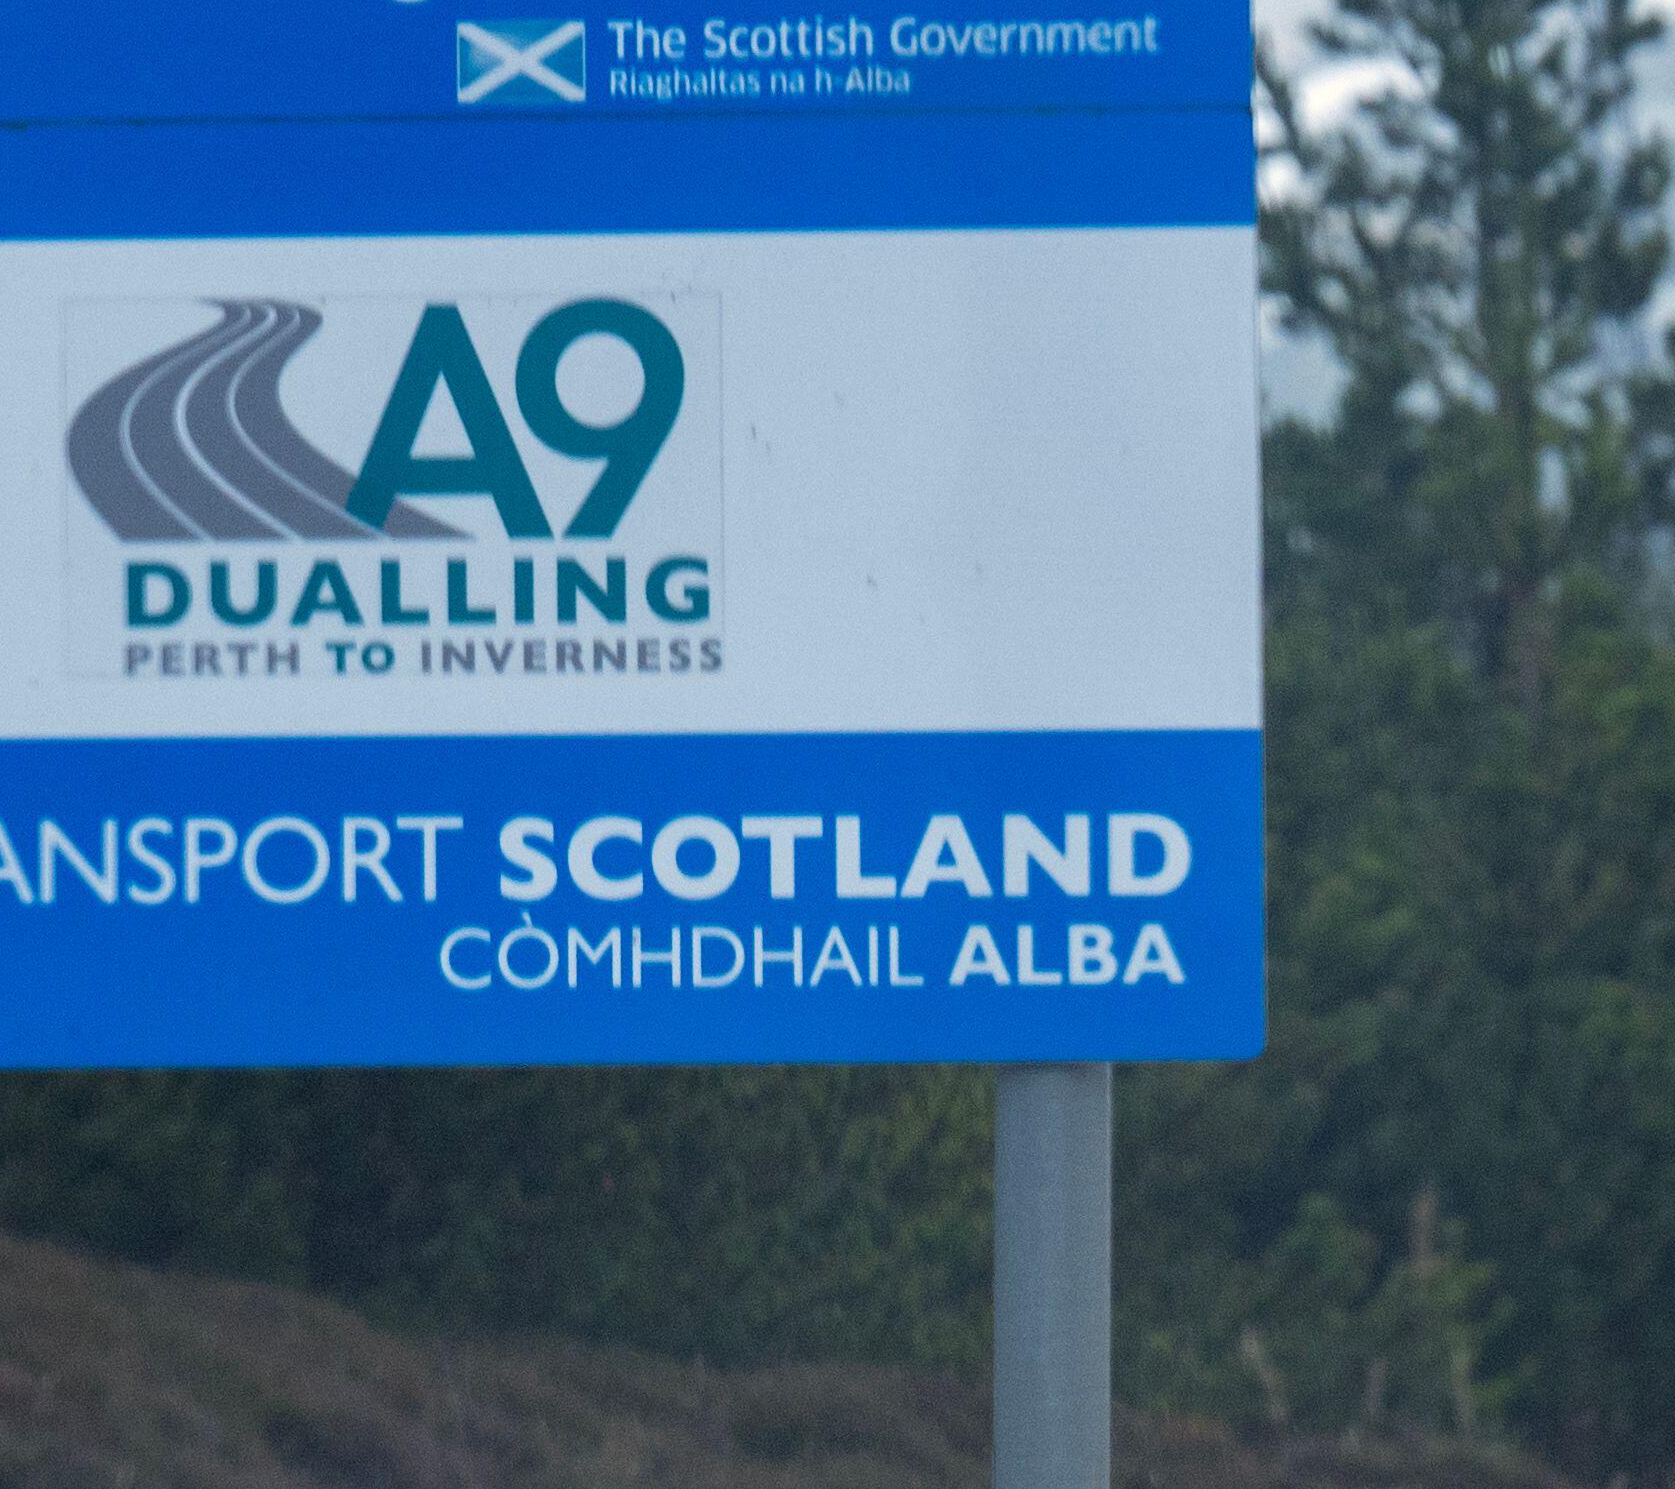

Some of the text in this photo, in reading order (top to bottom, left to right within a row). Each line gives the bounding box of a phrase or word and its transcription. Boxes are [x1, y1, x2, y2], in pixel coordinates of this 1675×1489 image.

[608, 17, 1156, 58] The Scottish Government
[609, 69, 760, 98] Riaghaltas
[770, 73, 805, 92] na
[347, 296, 685, 540] A9
[127, 557, 709, 627] DUALLING
[124, 640, 721, 677] PERTH TO INVERNESS
[500, 814, 1191, 900] SCOTLAND
[440, 911, 1184, 989] CÒMHDHAIL ALBA
